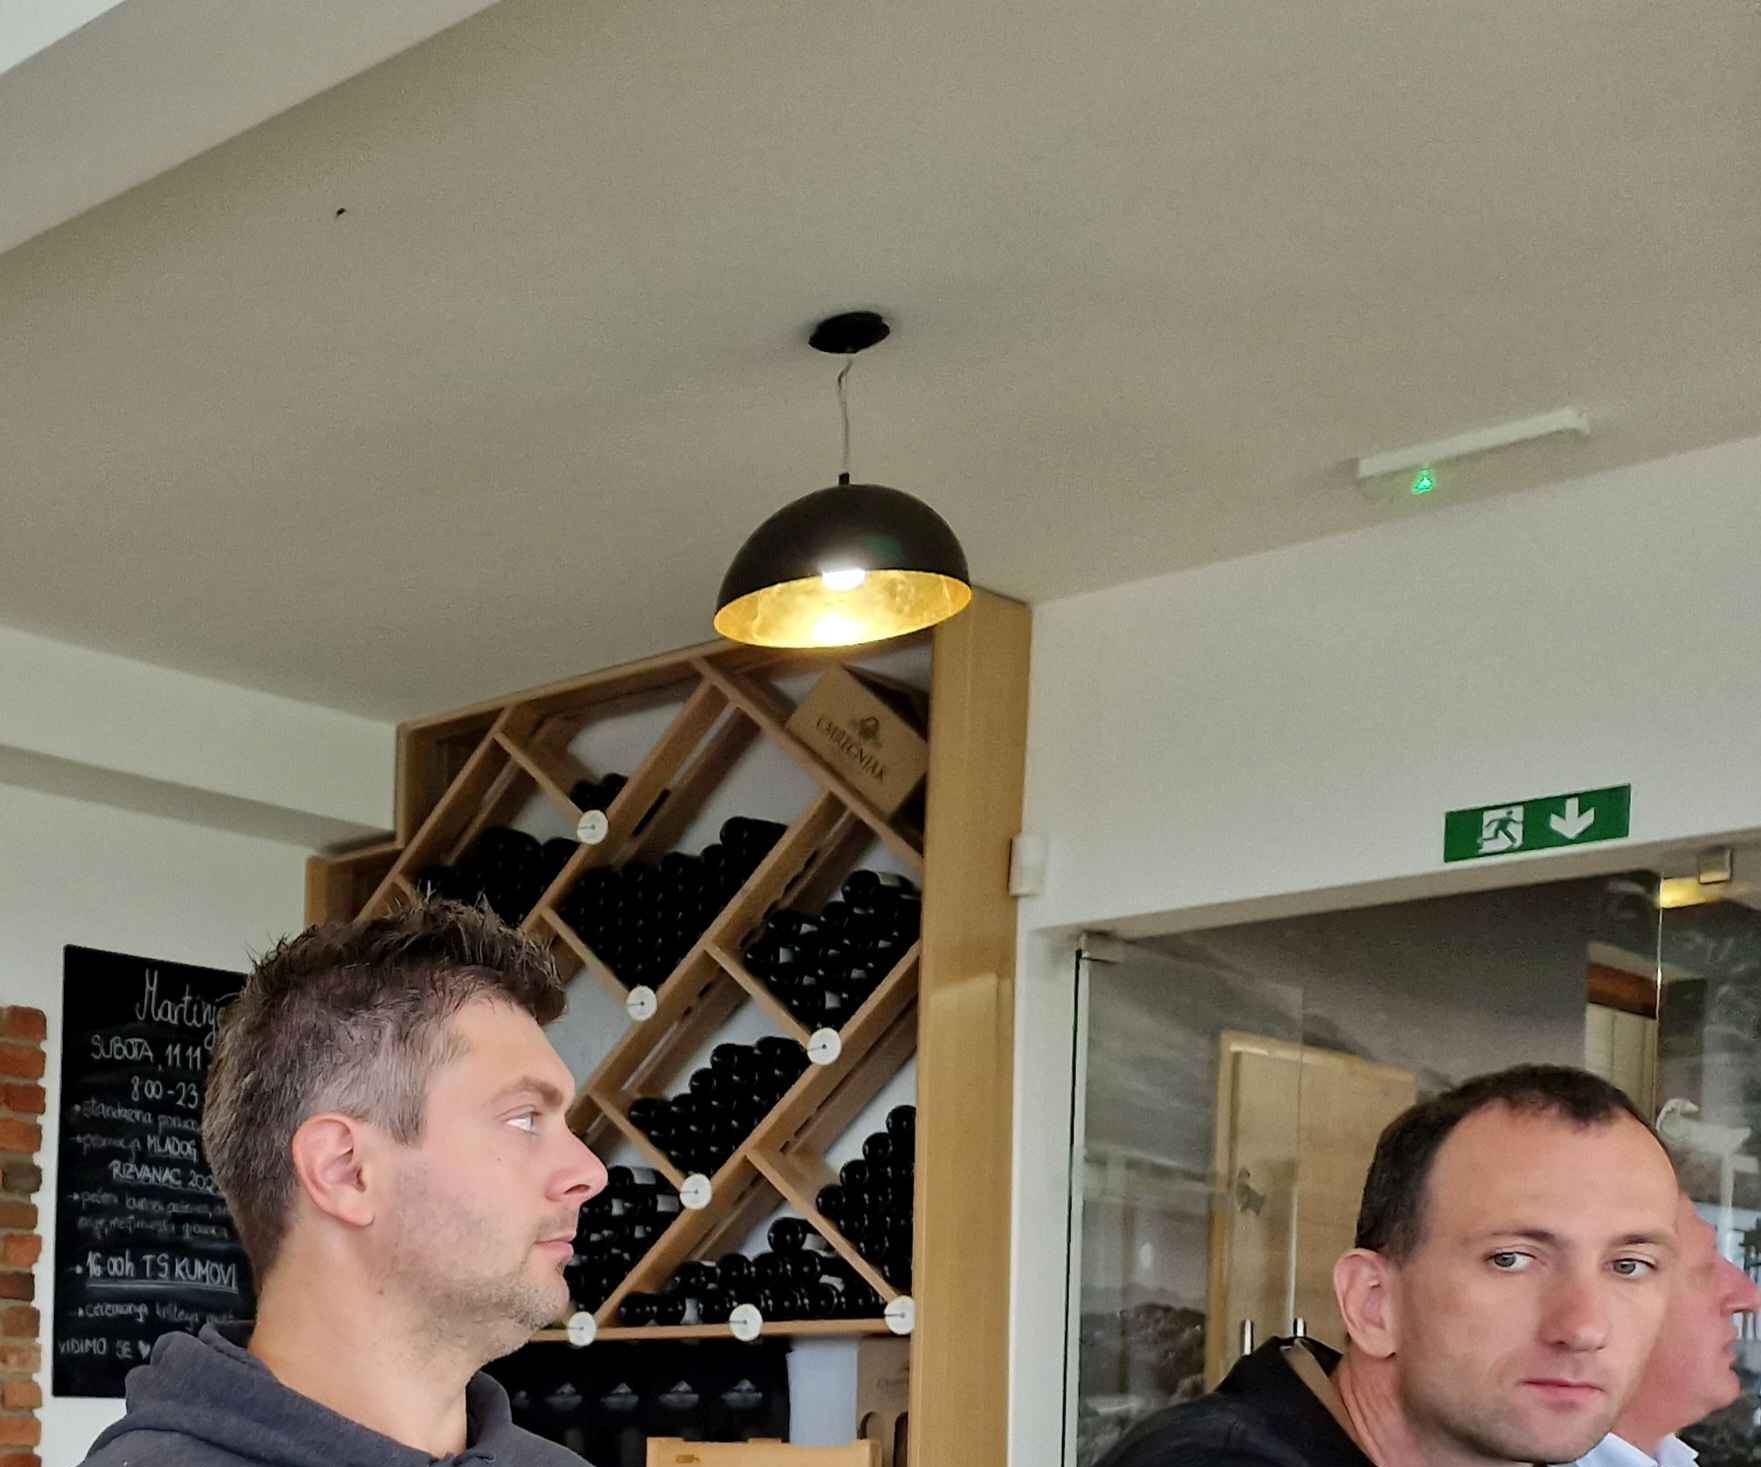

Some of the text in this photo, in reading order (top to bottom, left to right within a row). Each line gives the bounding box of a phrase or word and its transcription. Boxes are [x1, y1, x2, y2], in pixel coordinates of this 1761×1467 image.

[134, 968, 218, 1051] Martinj
[108, 1159, 218, 1194] RIZVANAC 202
[174, 1256, 239, 1291] KUMOVI
